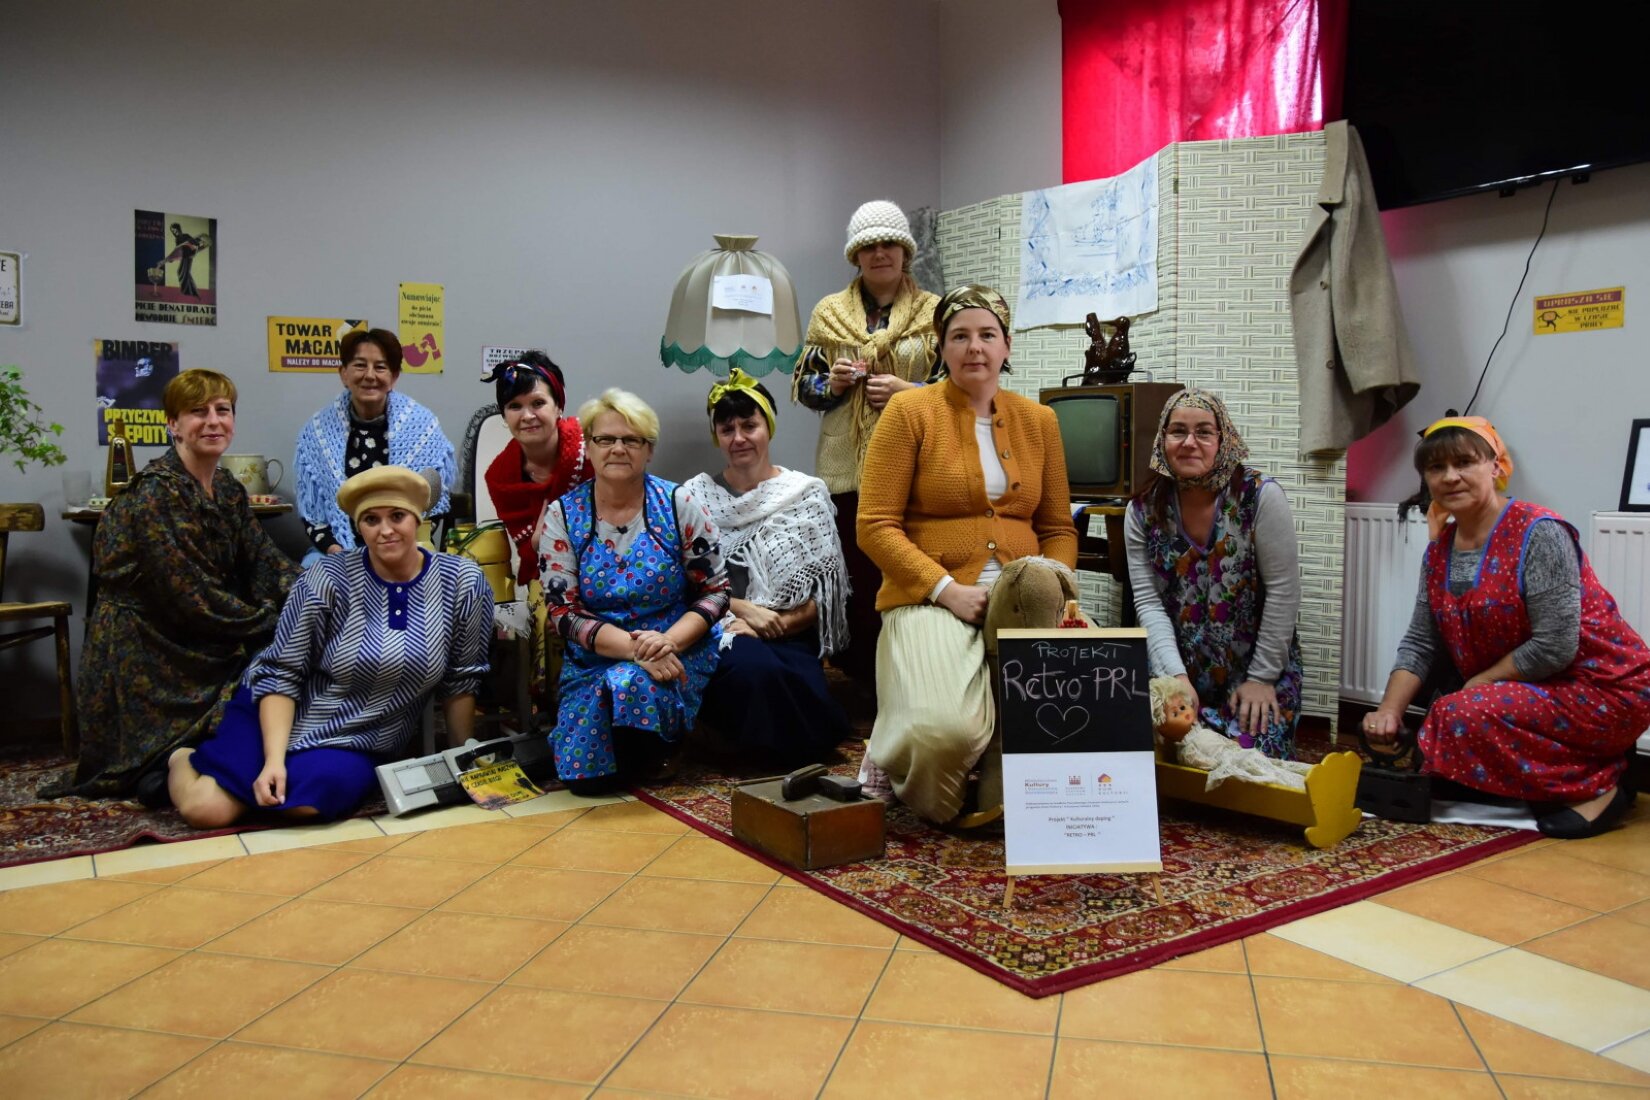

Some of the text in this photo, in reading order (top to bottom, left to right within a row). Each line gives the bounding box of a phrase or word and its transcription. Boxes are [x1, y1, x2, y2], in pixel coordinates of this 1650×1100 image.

[1543, 296, 1593, 307] UPRASZA
[276, 323, 332, 337] TOWAR
[285, 339, 342, 356] MACAN
[104, 408, 168, 425] PRZYCZYN
[1032, 641, 1132, 666] PROJEKT
